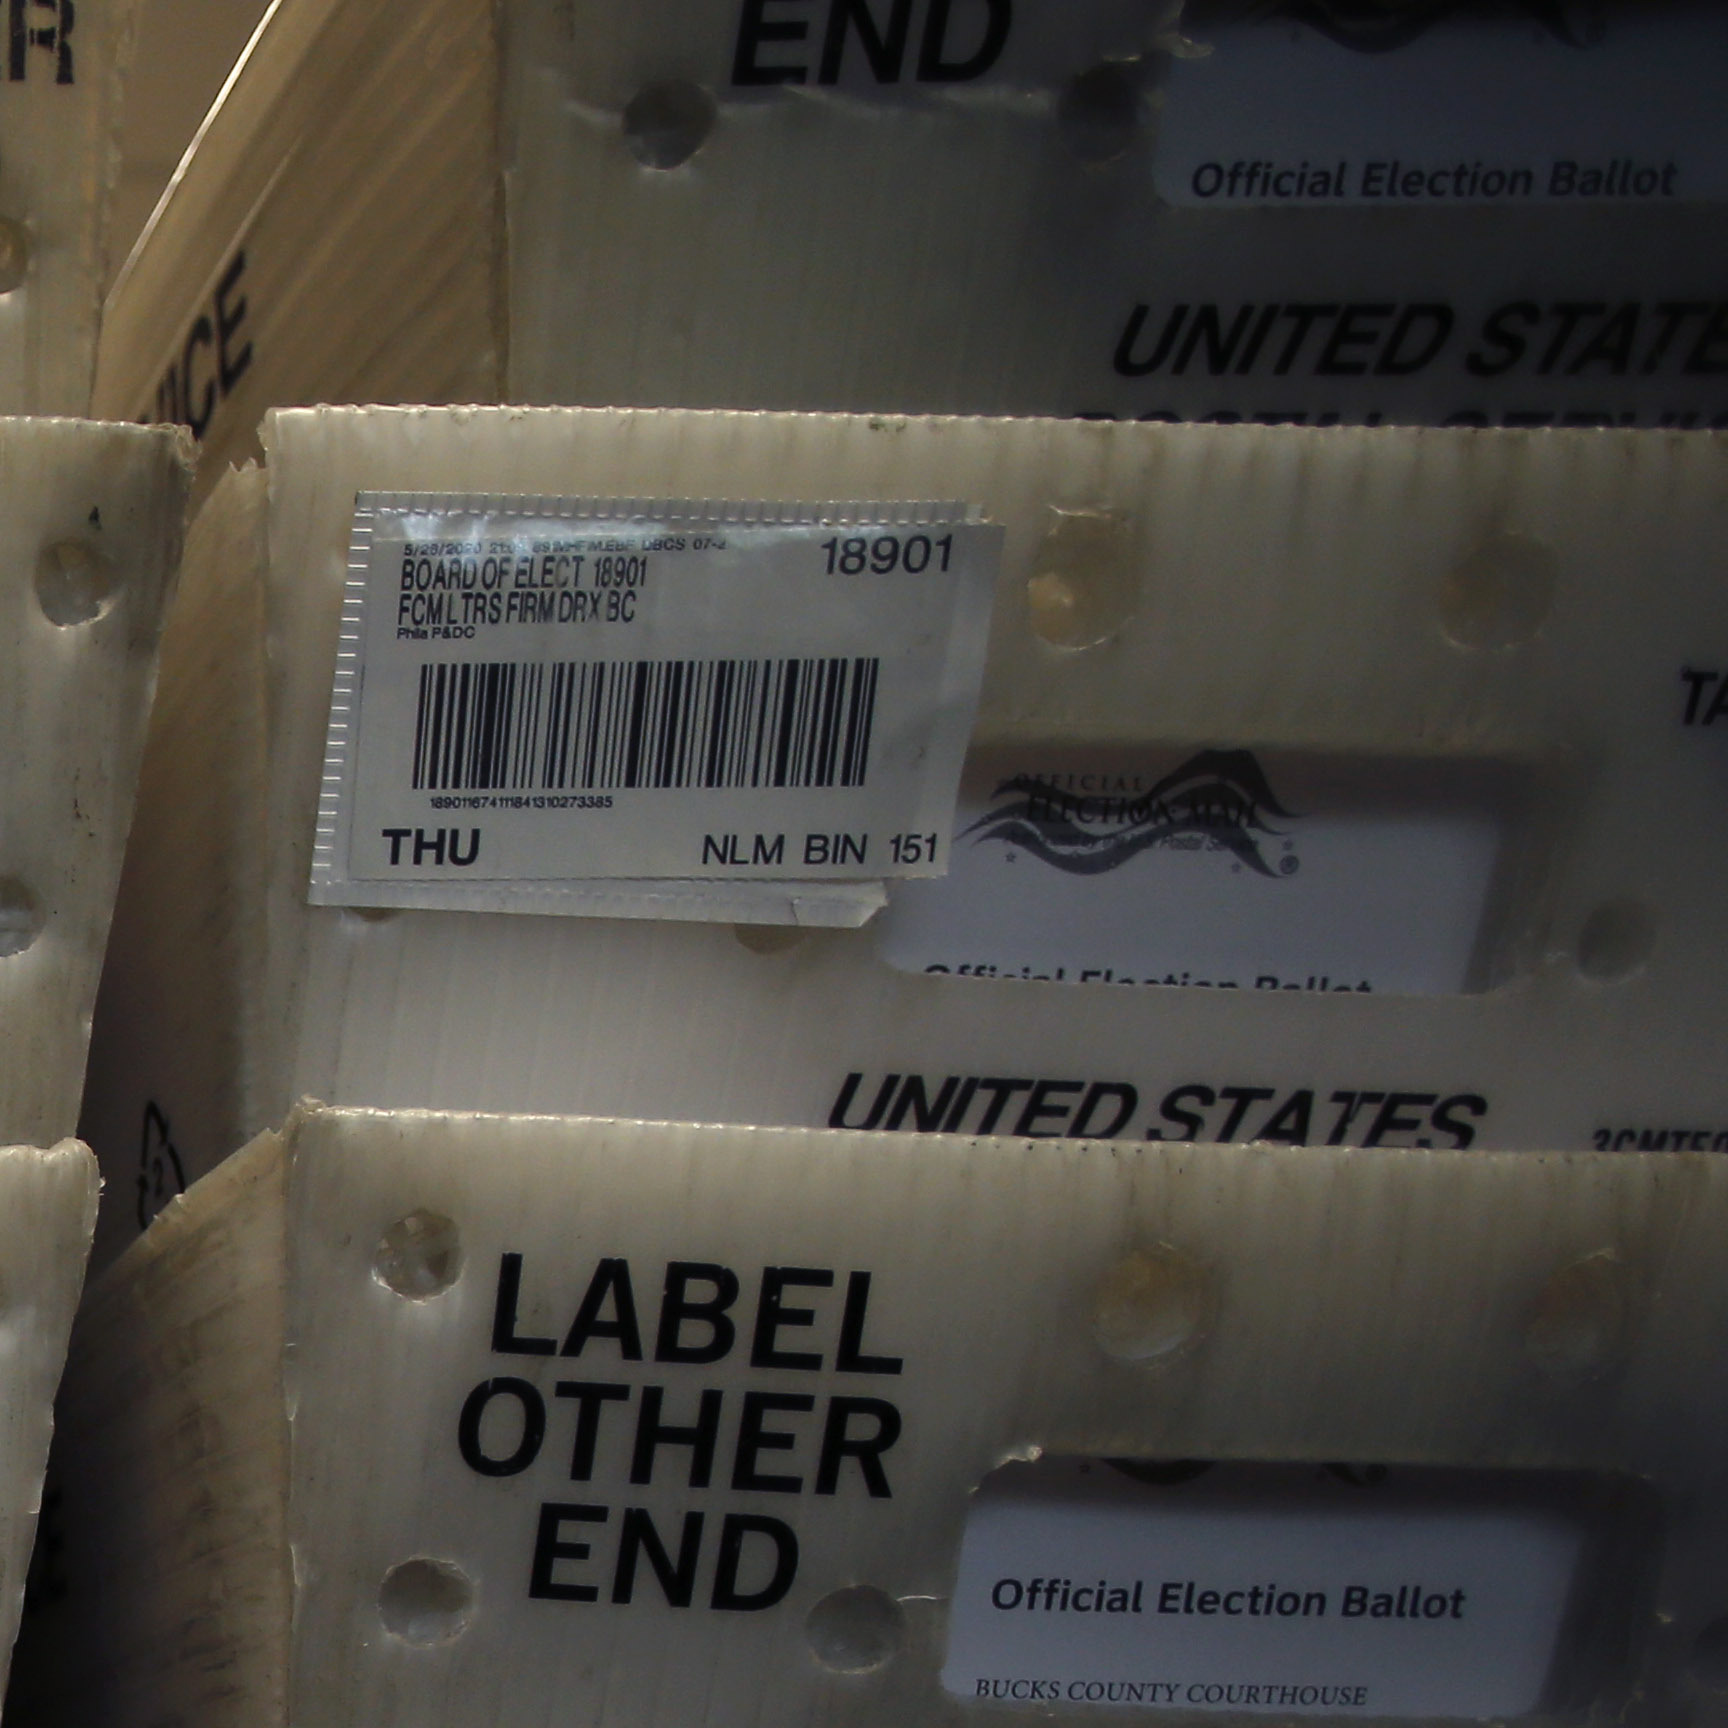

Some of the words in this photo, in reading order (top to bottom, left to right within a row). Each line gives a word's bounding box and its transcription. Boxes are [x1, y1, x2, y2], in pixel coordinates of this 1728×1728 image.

[1192, 160, 1346, 197] Official
[1358, 157, 1536, 200] Election
[1550, 157, 1676, 199] Ballot
[401, 557, 477, 591] BOARD
[481, 557, 510, 588] OF
[514, 555, 585, 588] ELECT
[594, 557, 647, 587] 18901
[820, 535, 954, 575] 18901
[506, 591, 554, 623] FIRM
[557, 590, 600, 623] DRX
[606, 589, 636, 623] BC
[383, 828, 479, 866] THU
[702, 834, 784, 864] NLM
[804, 834, 866, 863] BIN
[890, 834, 938, 863] 151
[488, 1252, 903, 1374] LABEL
[458, 1377, 902, 1496] OTHER
[528, 1504, 799, 1611] END
[992, 1577, 1142, 1614] Official
[1157, 1582, 1326, 1617] Election
[1342, 1585, 1465, 1620] Ballot
[976, 1679, 1060, 1701] BUCKS
[1067, 1681, 1178, 1703] COUNTY
[1186, 1684, 1368, 1706] COURTHOUSE
